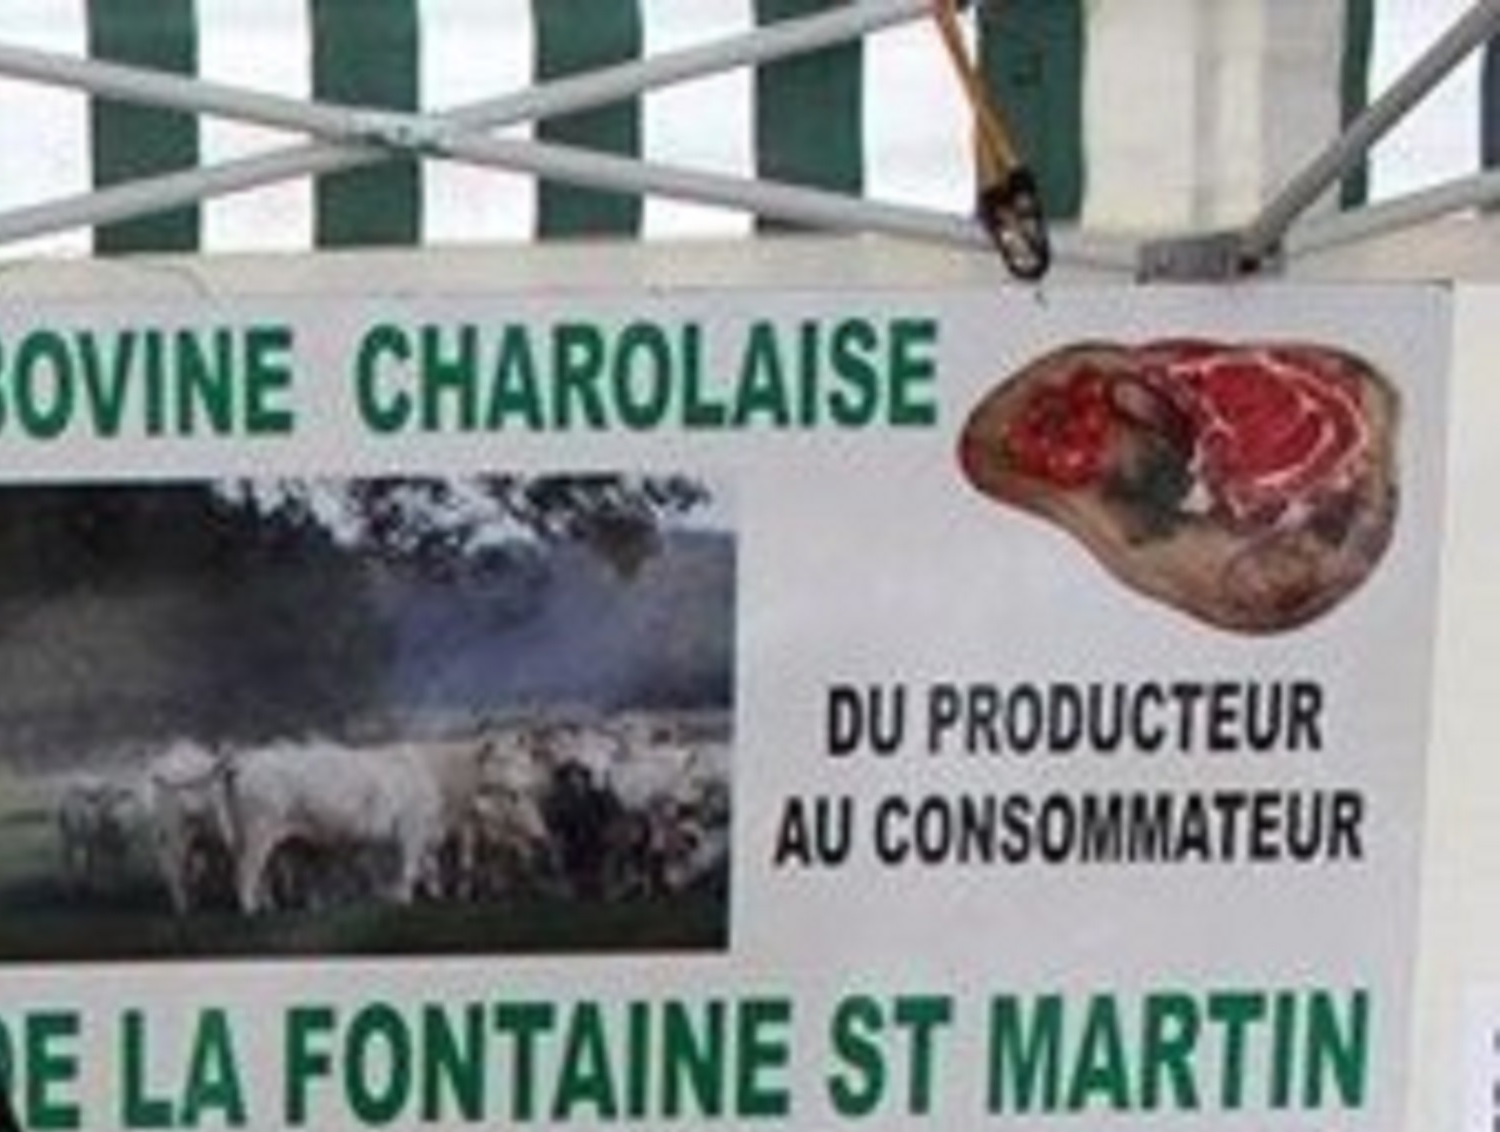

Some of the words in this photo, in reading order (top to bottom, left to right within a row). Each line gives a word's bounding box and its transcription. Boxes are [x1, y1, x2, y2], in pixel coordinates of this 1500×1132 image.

[355, 319, 938, 432] CHAROLAISE
[826, 684, 905, 756] DU
[928, 681, 1325, 754] PRODUCTEUR
[773, 796, 853, 866] AU
[874, 790, 1366, 865] CONSOMMATEUR
[121, 1007, 247, 1129] LA
[285, 999, 791, 1127] FONTAINE
[828, 995, 952, 1117] ST
[987, 989, 1369, 1113] MARTIN
